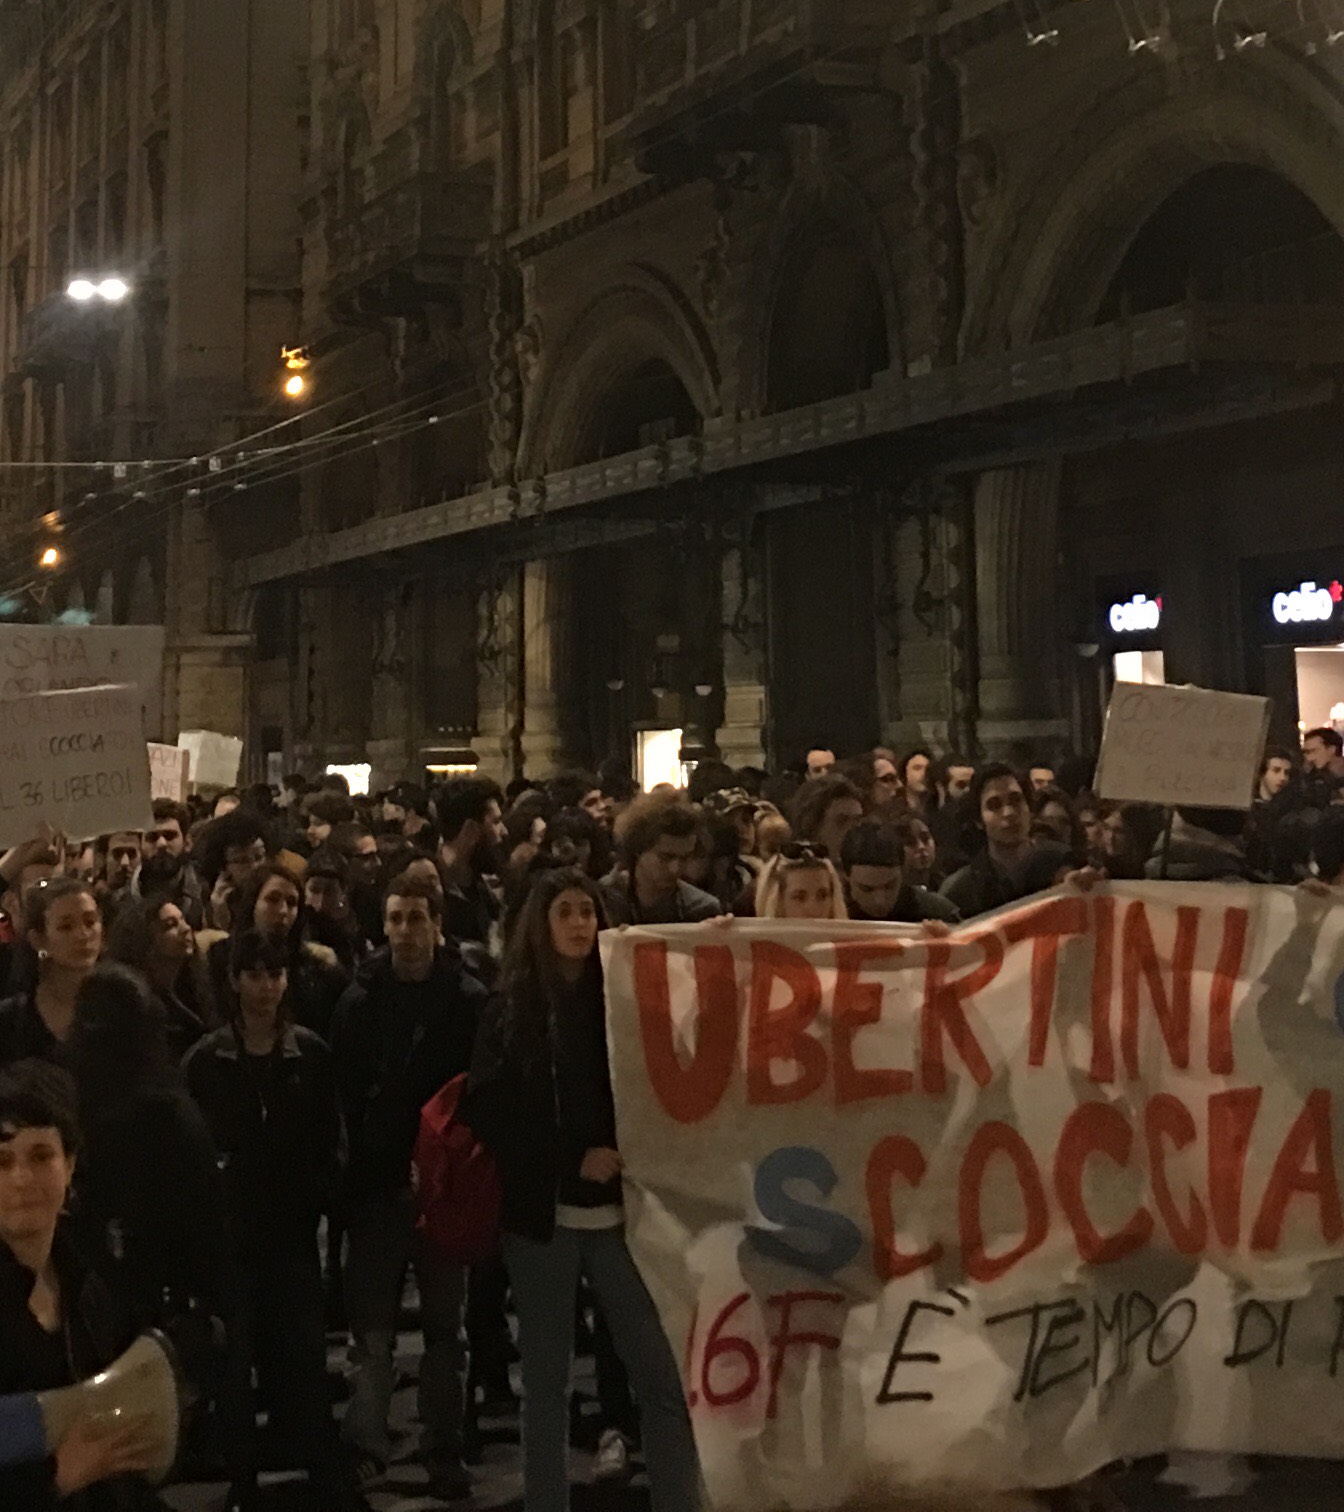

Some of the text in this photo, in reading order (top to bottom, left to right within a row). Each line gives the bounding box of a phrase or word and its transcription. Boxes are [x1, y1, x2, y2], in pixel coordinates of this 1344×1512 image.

[19, 780, 44, 807] 36
[634, 896, 1249, 1125] UBERTINI
[984, 1290, 1197, 1403] TEMPO
[1223, 1299, 1294, 1368] DI
